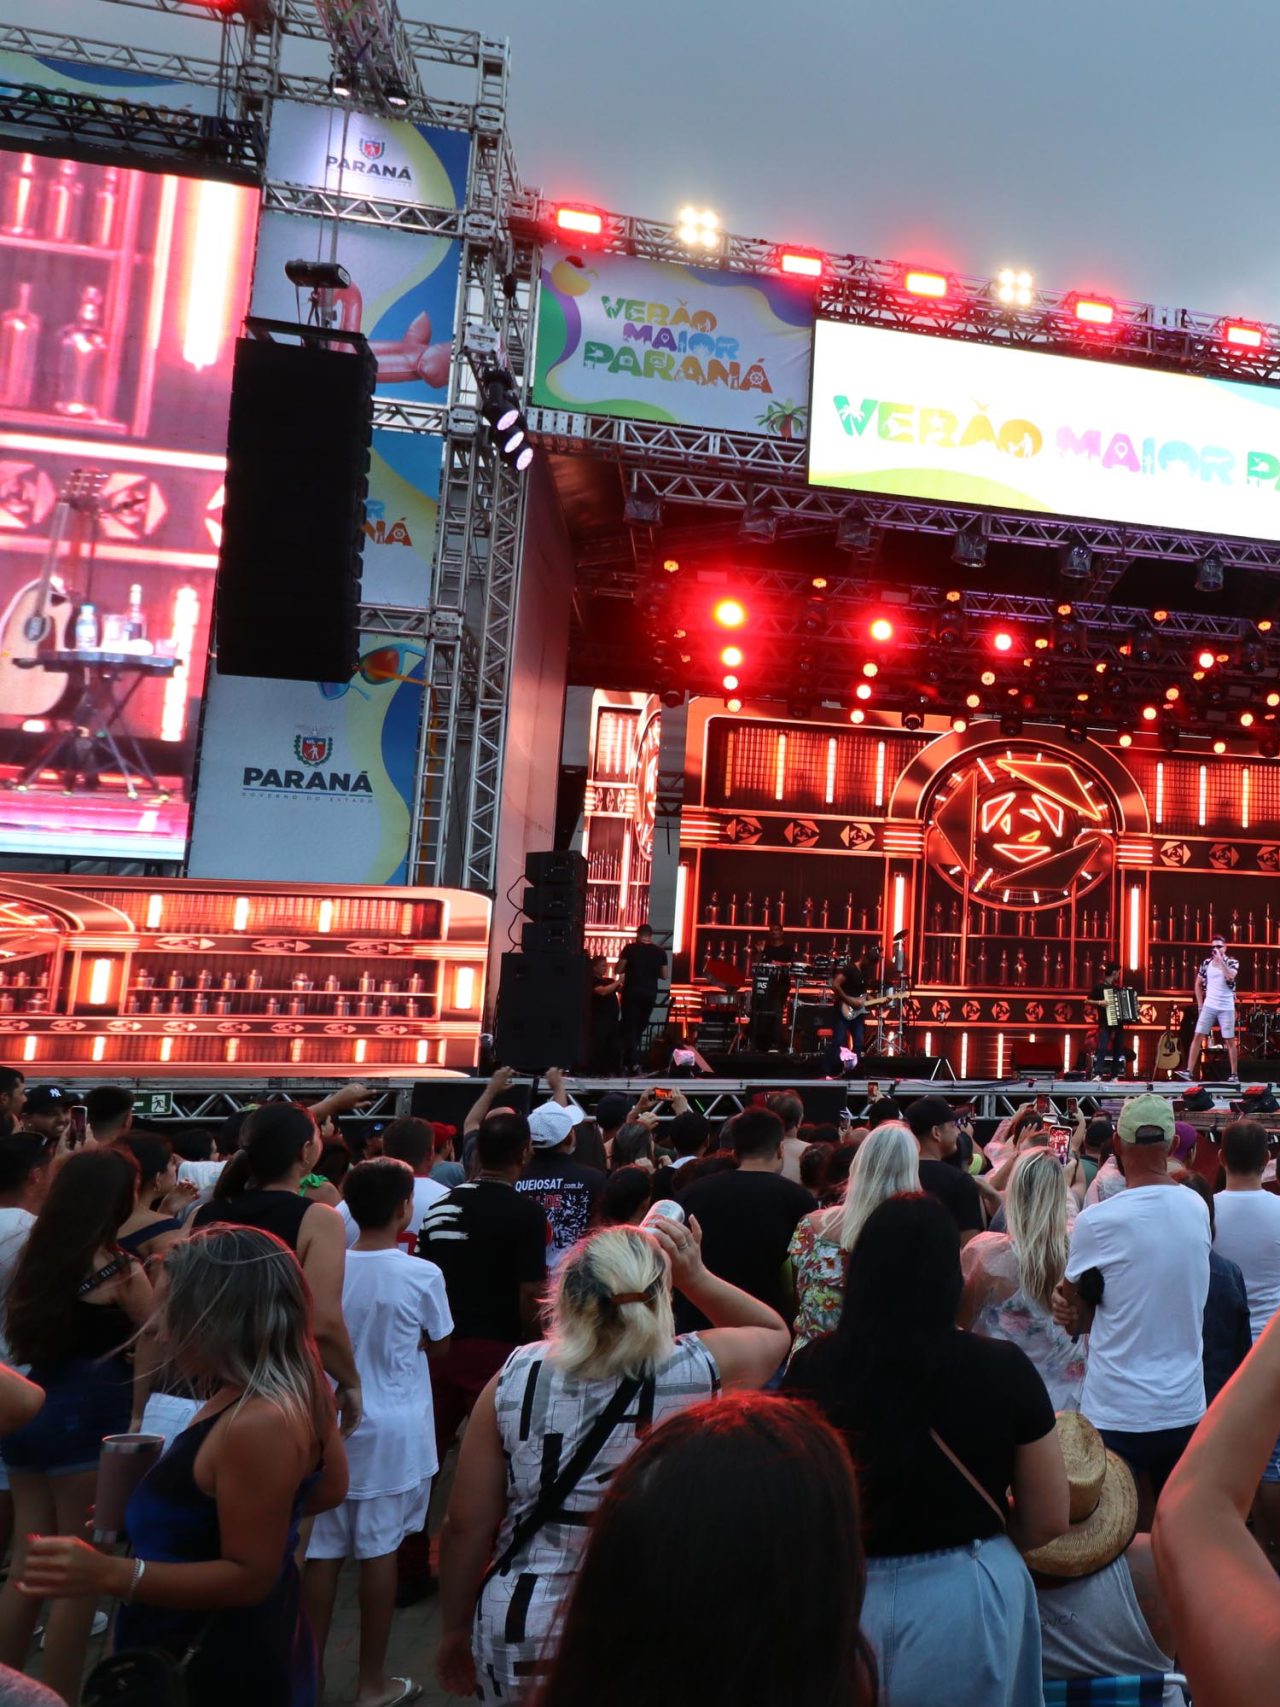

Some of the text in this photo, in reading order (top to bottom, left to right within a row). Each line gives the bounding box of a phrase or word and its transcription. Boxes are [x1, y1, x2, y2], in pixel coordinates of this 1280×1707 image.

[326, 156, 412, 180] PARANÁ
[601, 295, 717, 333] VERÃO
[623, 322, 740, 360] MAIOR
[583, 340, 773, 394] PARANÁ
[833, 394, 1043, 459] VERÃO
[1056, 425, 1236, 485] MAIOR
[242, 767, 373, 793] PARANÁ
